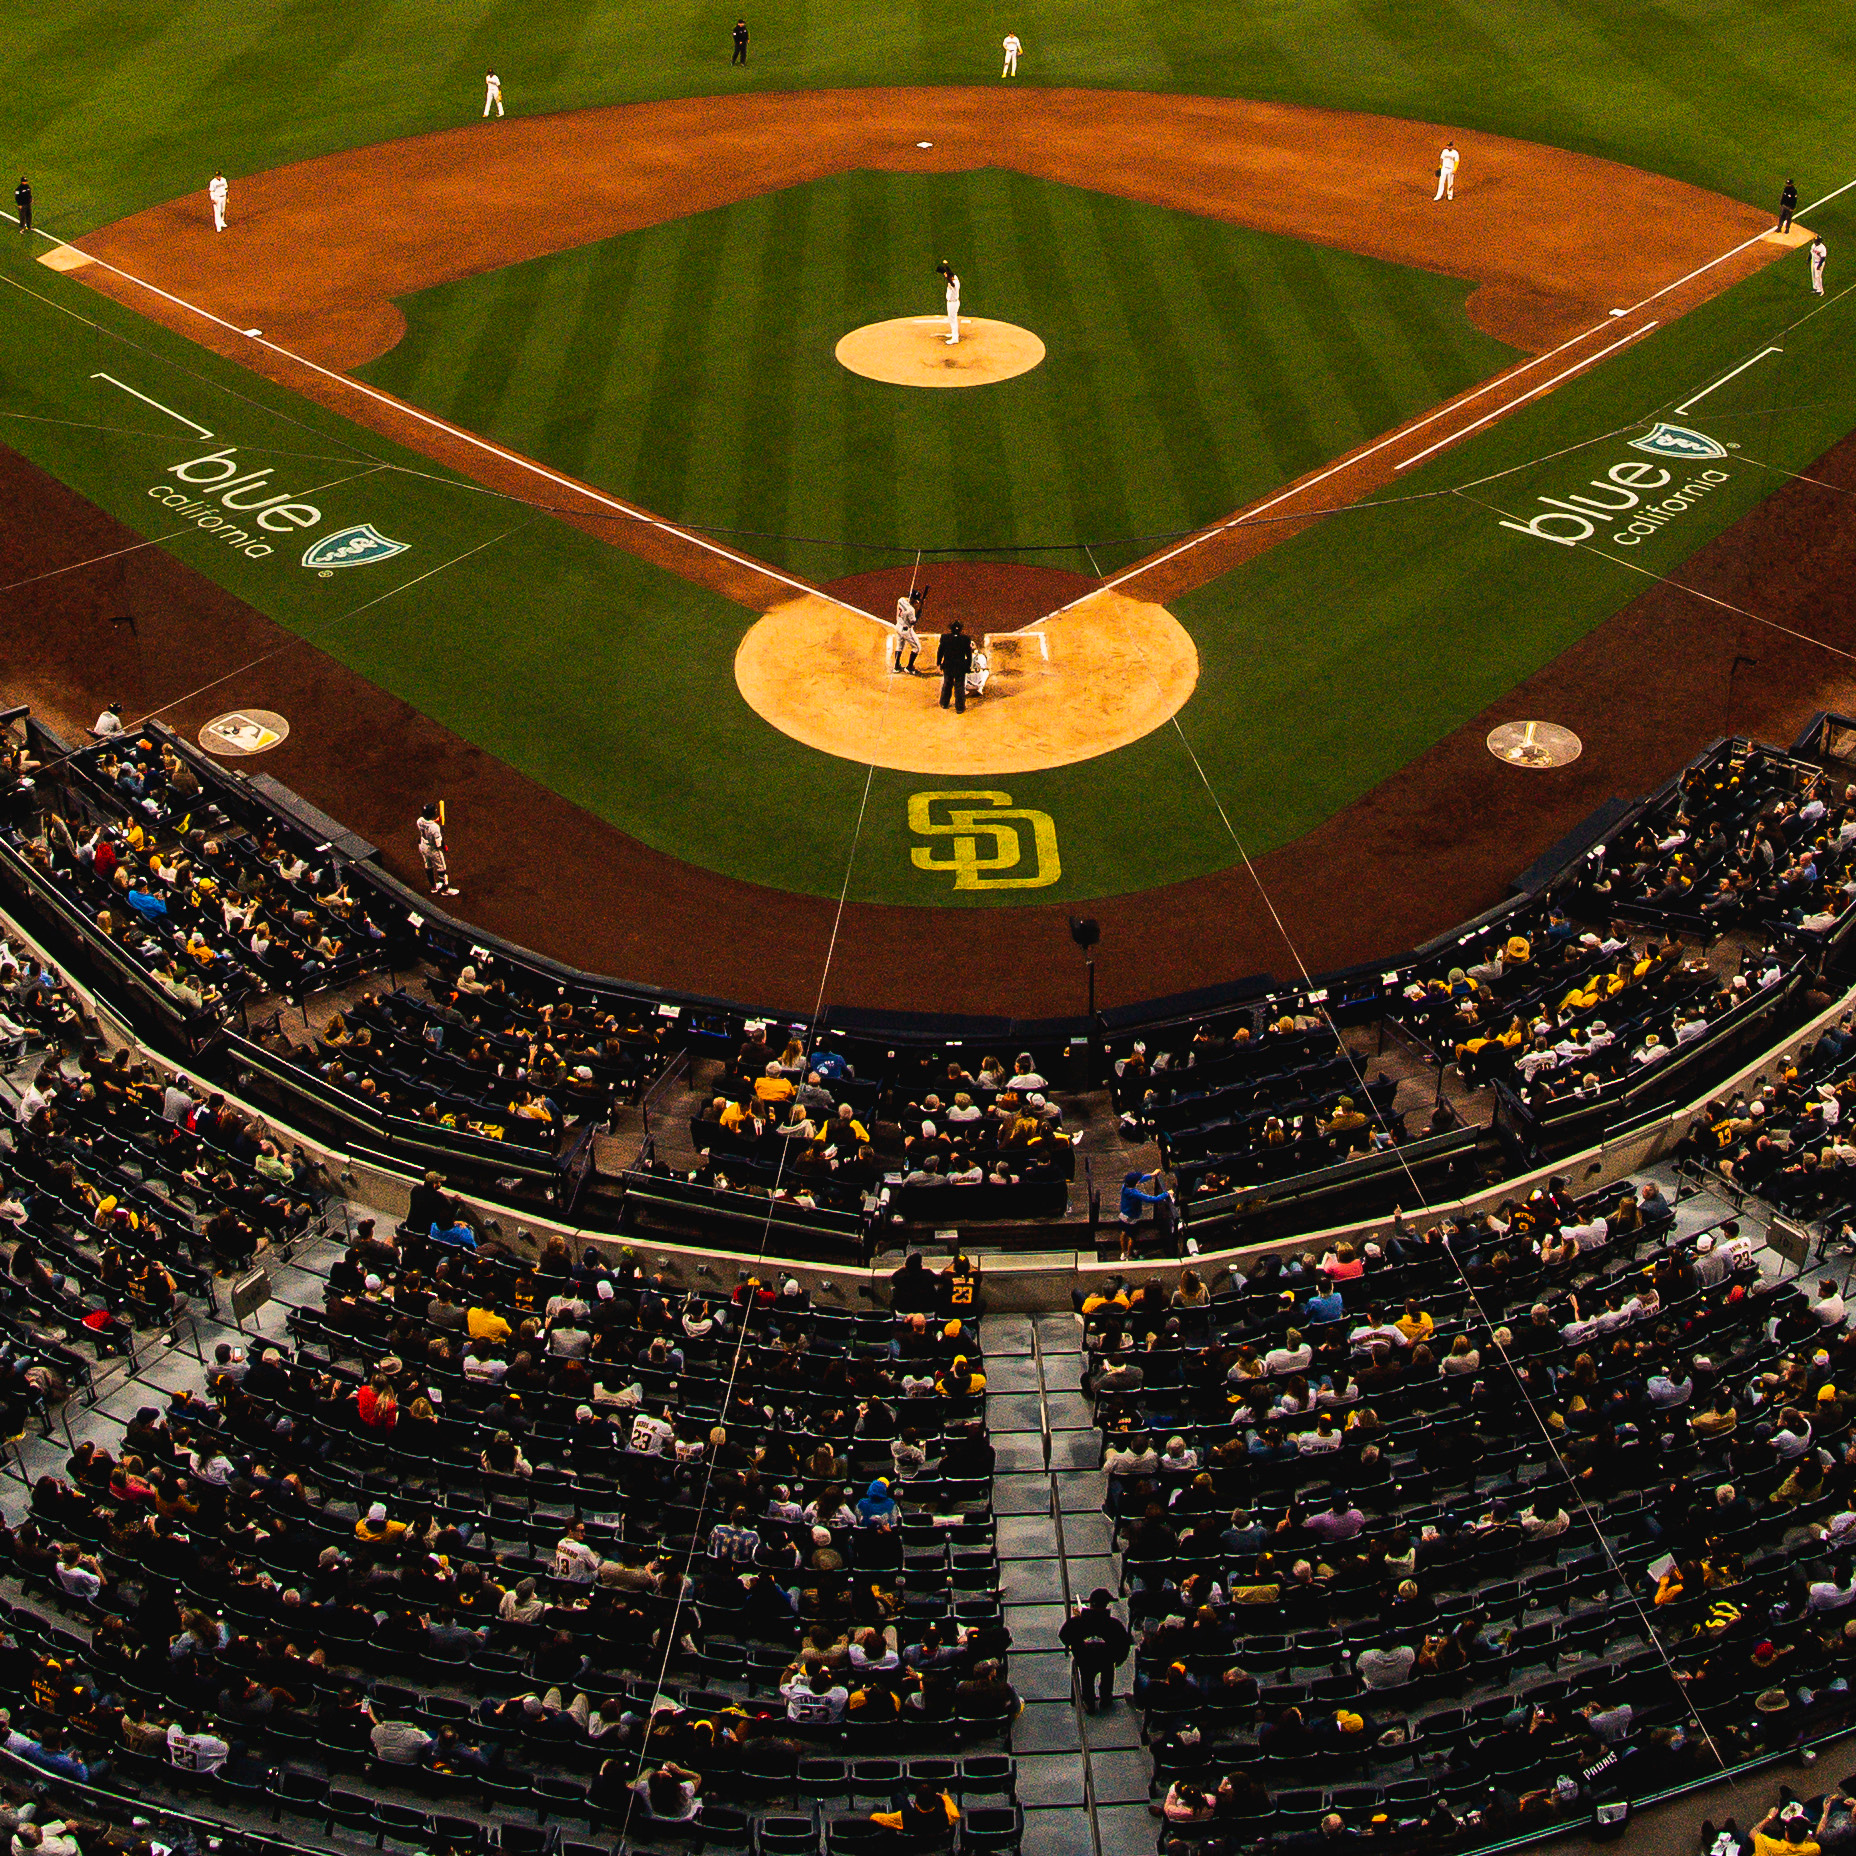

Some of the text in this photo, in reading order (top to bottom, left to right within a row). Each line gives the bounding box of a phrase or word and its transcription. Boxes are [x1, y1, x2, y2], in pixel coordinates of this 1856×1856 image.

[148, 485, 277, 559] california
[168, 448, 322, 533] blue
[1499, 462, 1672, 546] blue
[1613, 468, 1732, 546] california
[907, 791, 1062, 890] SD
